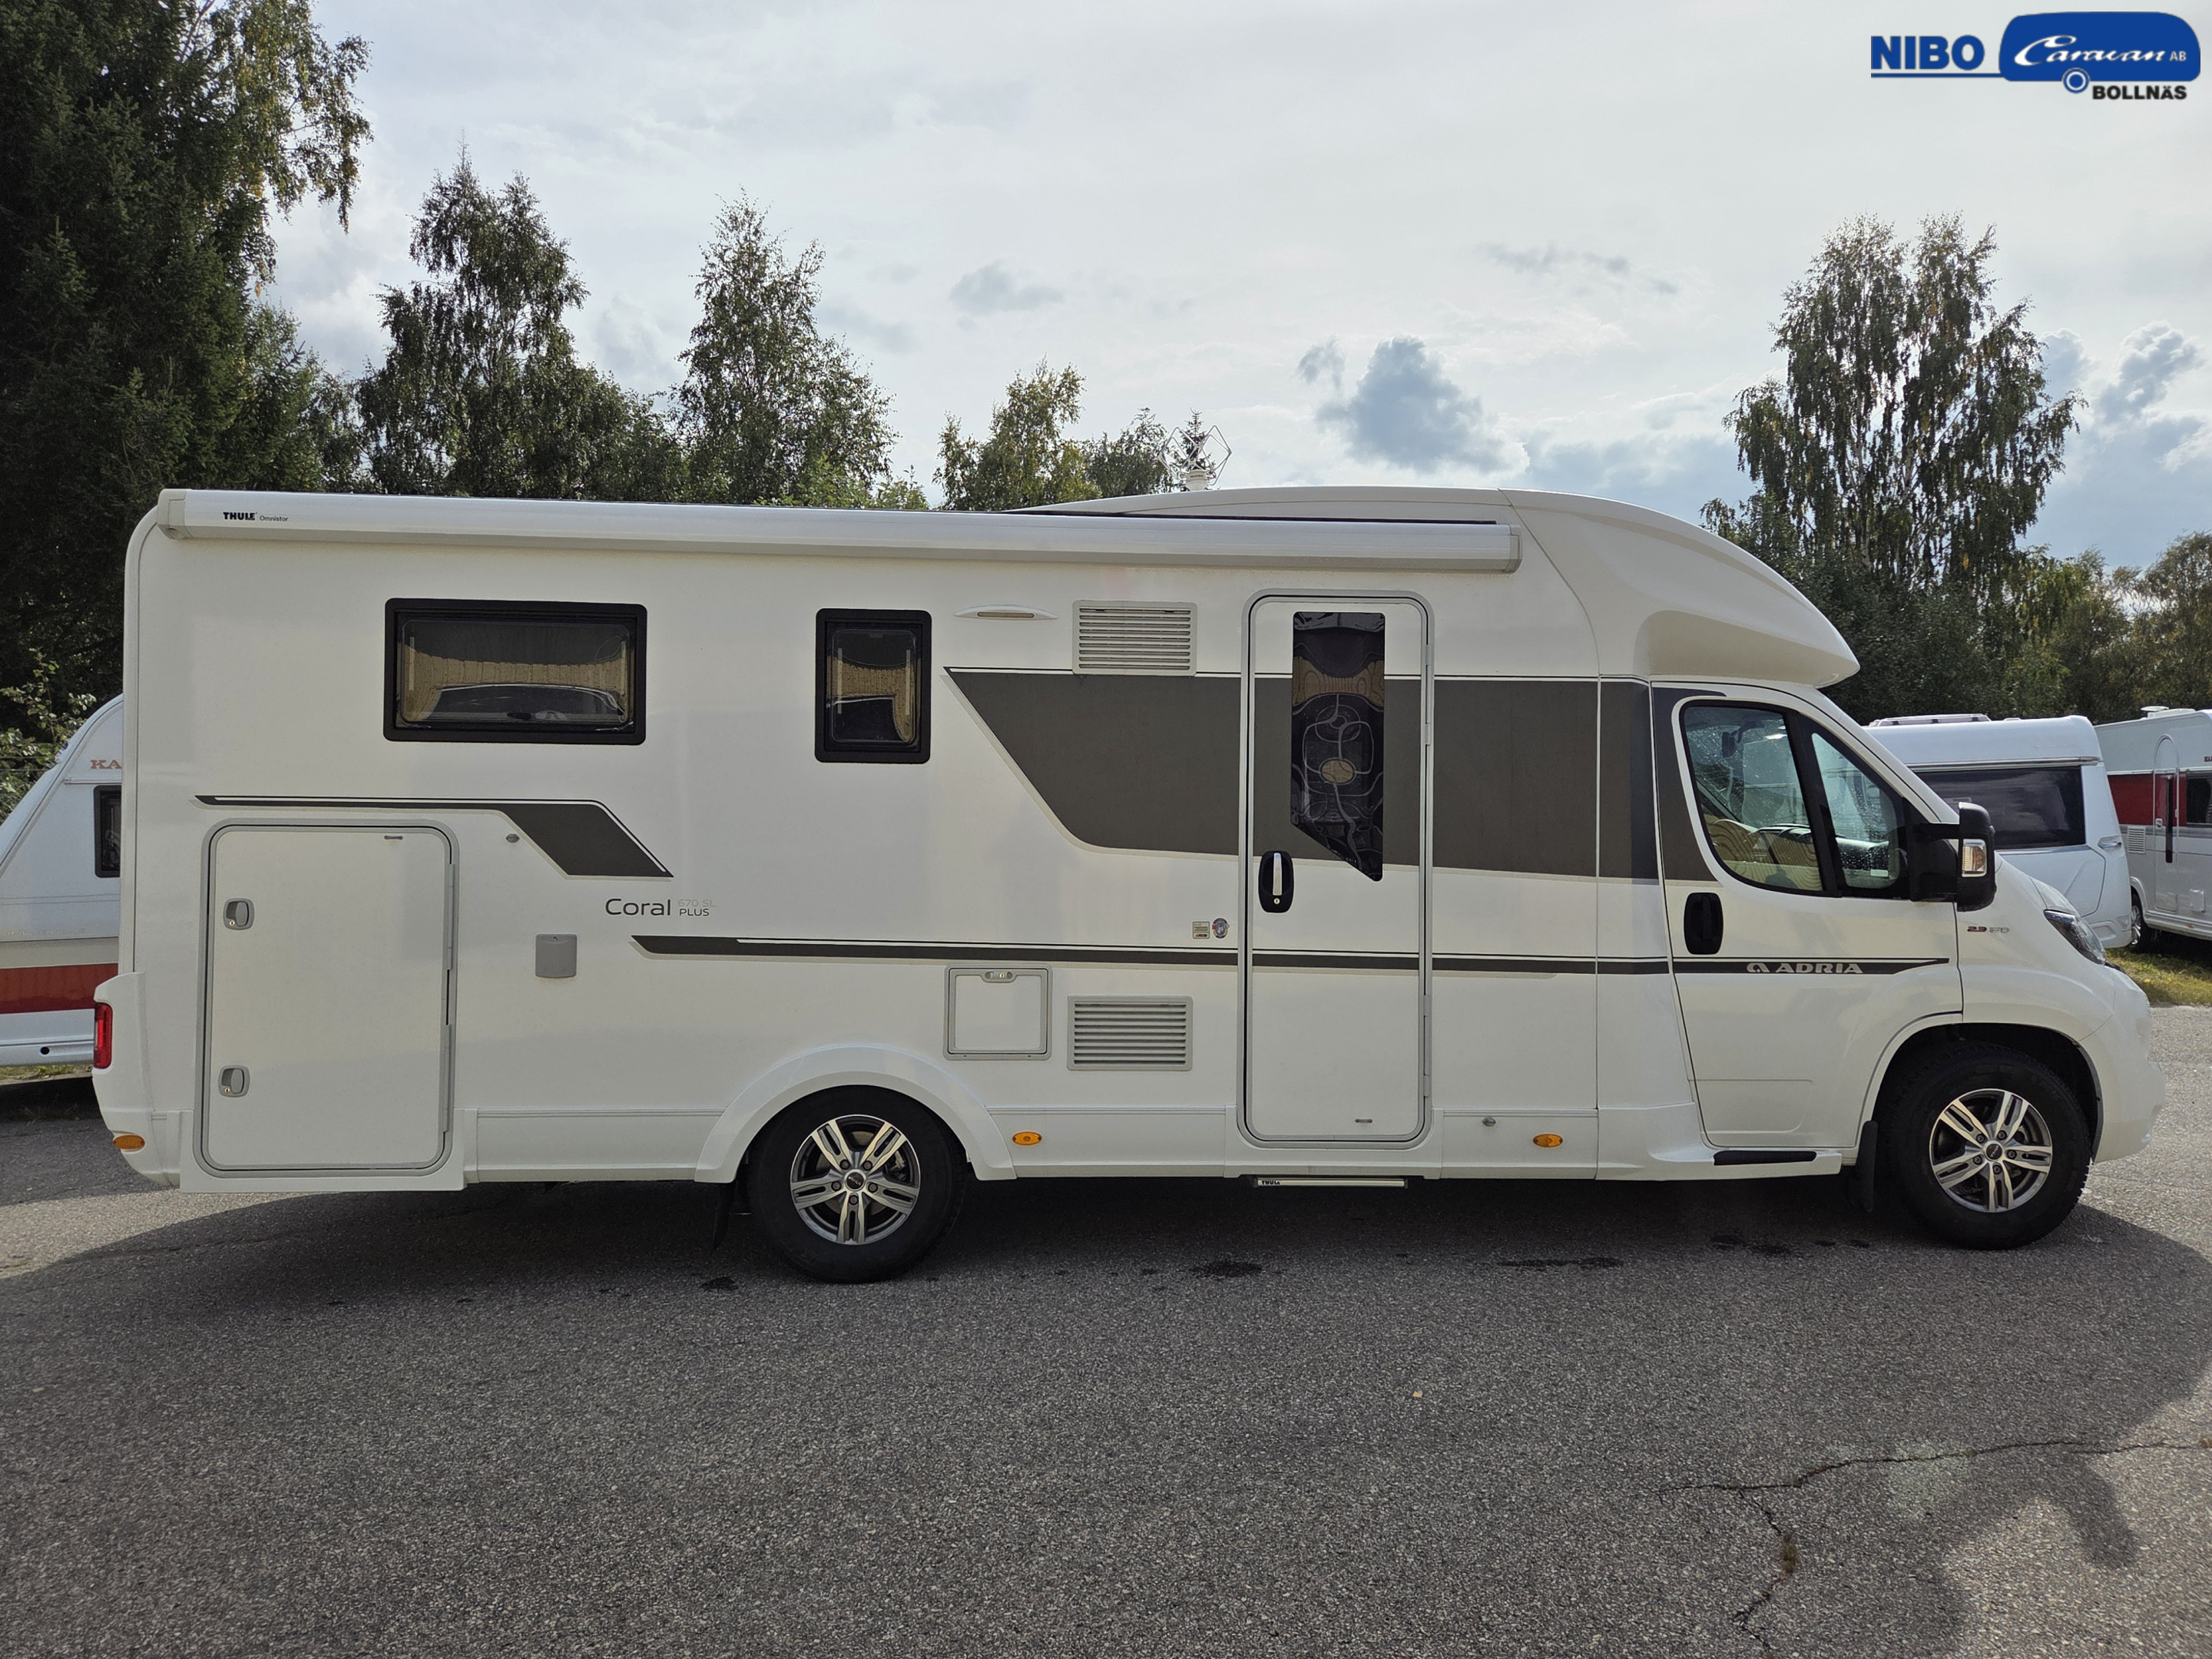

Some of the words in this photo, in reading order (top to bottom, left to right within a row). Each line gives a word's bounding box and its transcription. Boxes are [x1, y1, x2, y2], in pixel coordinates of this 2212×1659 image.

[223, 512, 256, 521] THULE
[605, 898, 671, 916] Coral
[677, 899, 699, 907] 670
[702, 899, 716, 908] SL
[679, 908, 710, 916] PLUS
[1775, 962, 1863, 974] ADRIA
